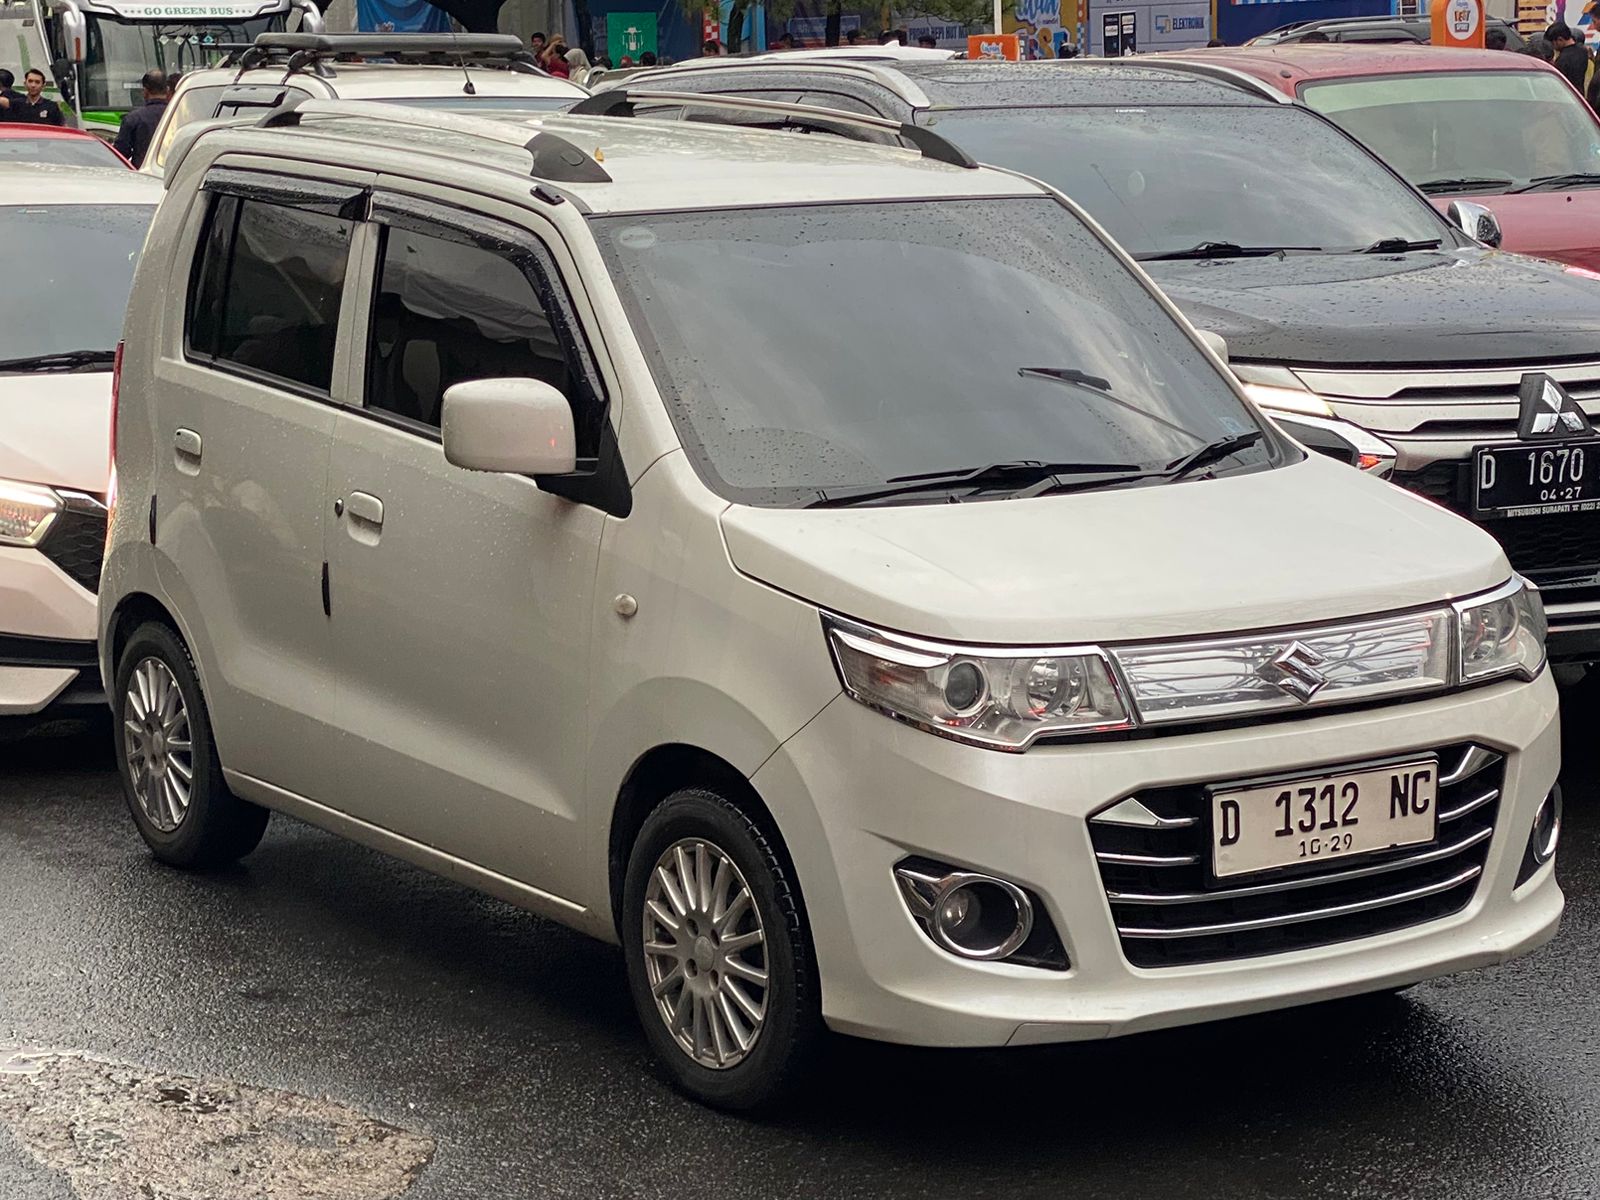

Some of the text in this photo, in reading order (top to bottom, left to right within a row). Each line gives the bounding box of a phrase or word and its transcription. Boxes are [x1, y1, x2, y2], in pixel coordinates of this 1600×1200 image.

[144, 7, 234, 15] GO GREEN BUS
[1481, 448, 1584, 489] D 1670
[1507, 507, 1541, 518] MITSUBISHI
[1542, 504, 1570, 515] SURAPATI
[1220, 770, 1431, 846] D 1312 NC
